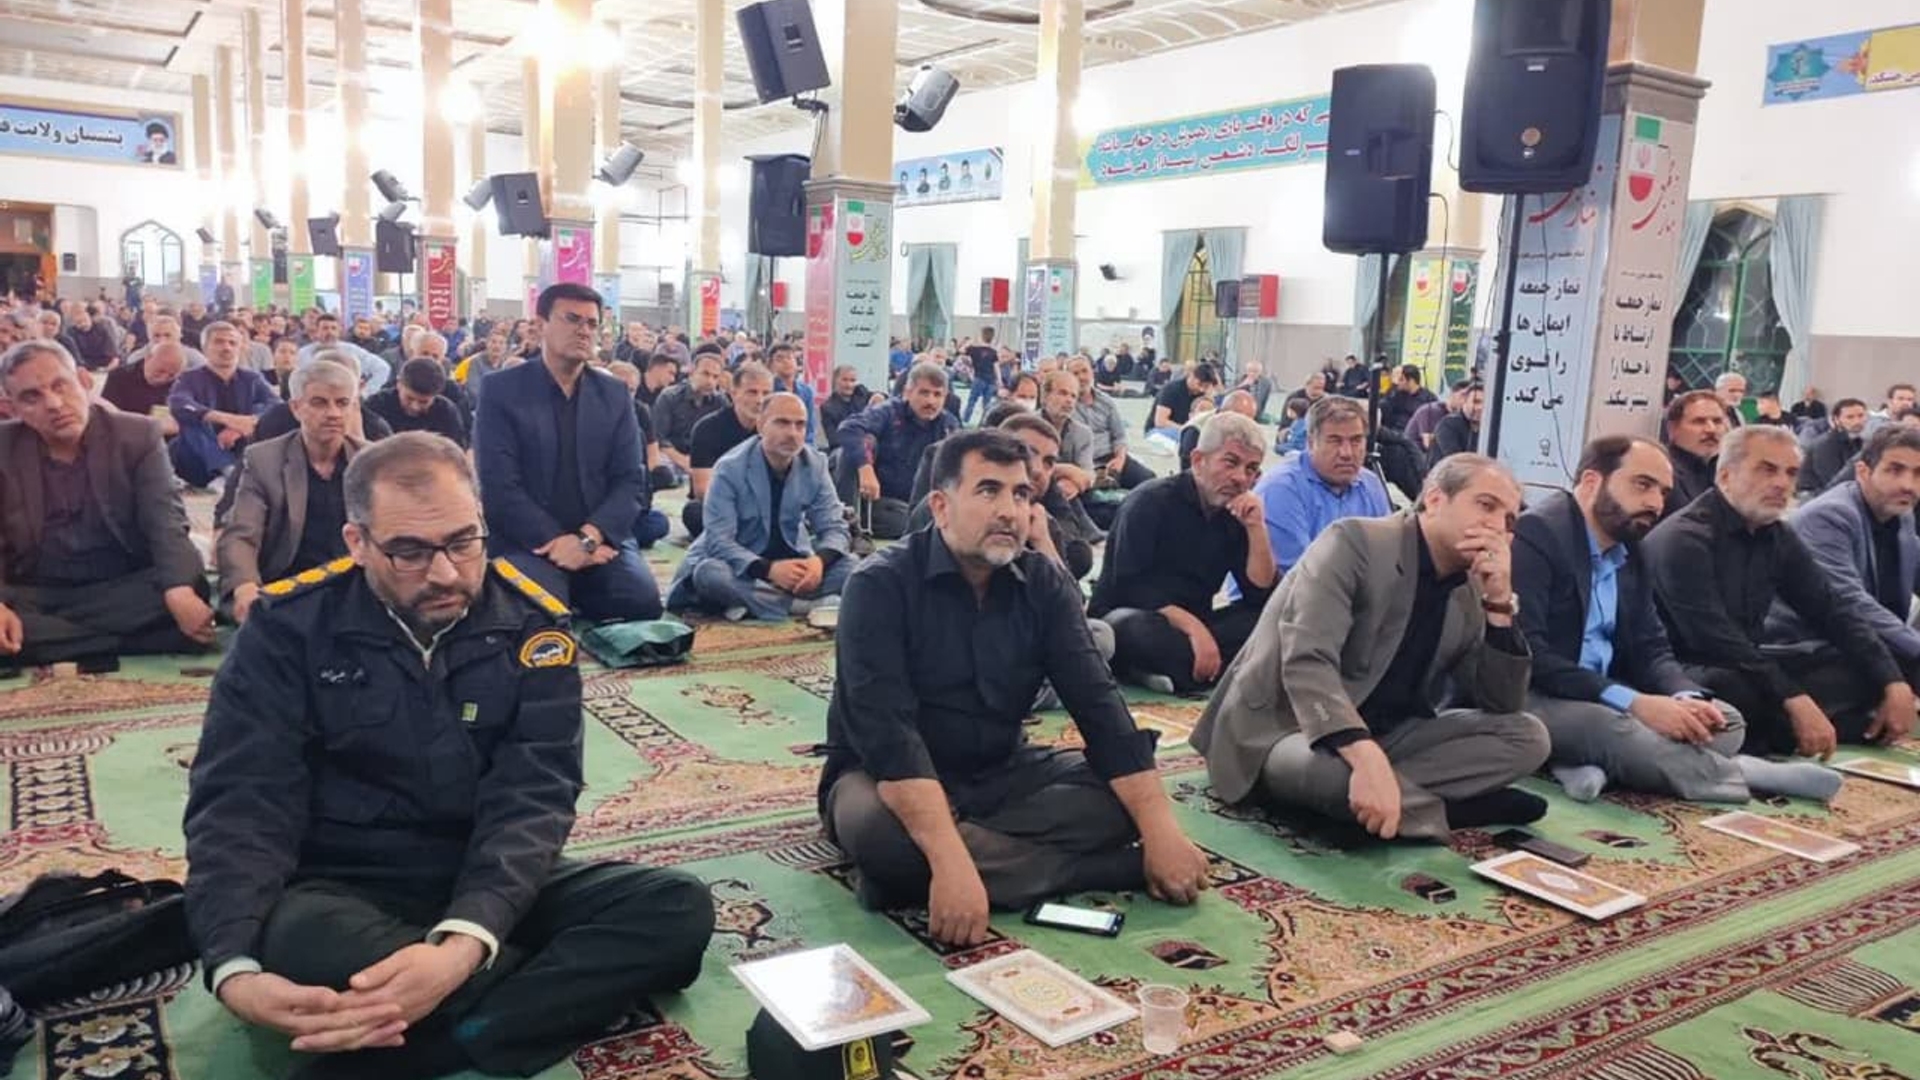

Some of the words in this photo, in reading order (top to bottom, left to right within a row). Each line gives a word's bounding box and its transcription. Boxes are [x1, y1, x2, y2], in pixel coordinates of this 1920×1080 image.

[1518, 281, 1552, 295] جمعه
[1555, 277, 1581, 301] نماز
[1516, 312, 1531, 331] ها
[1533, 312, 1572, 337] ایمان
[1555, 350, 1567, 375] را
[1541, 394, 1565, 410] می
